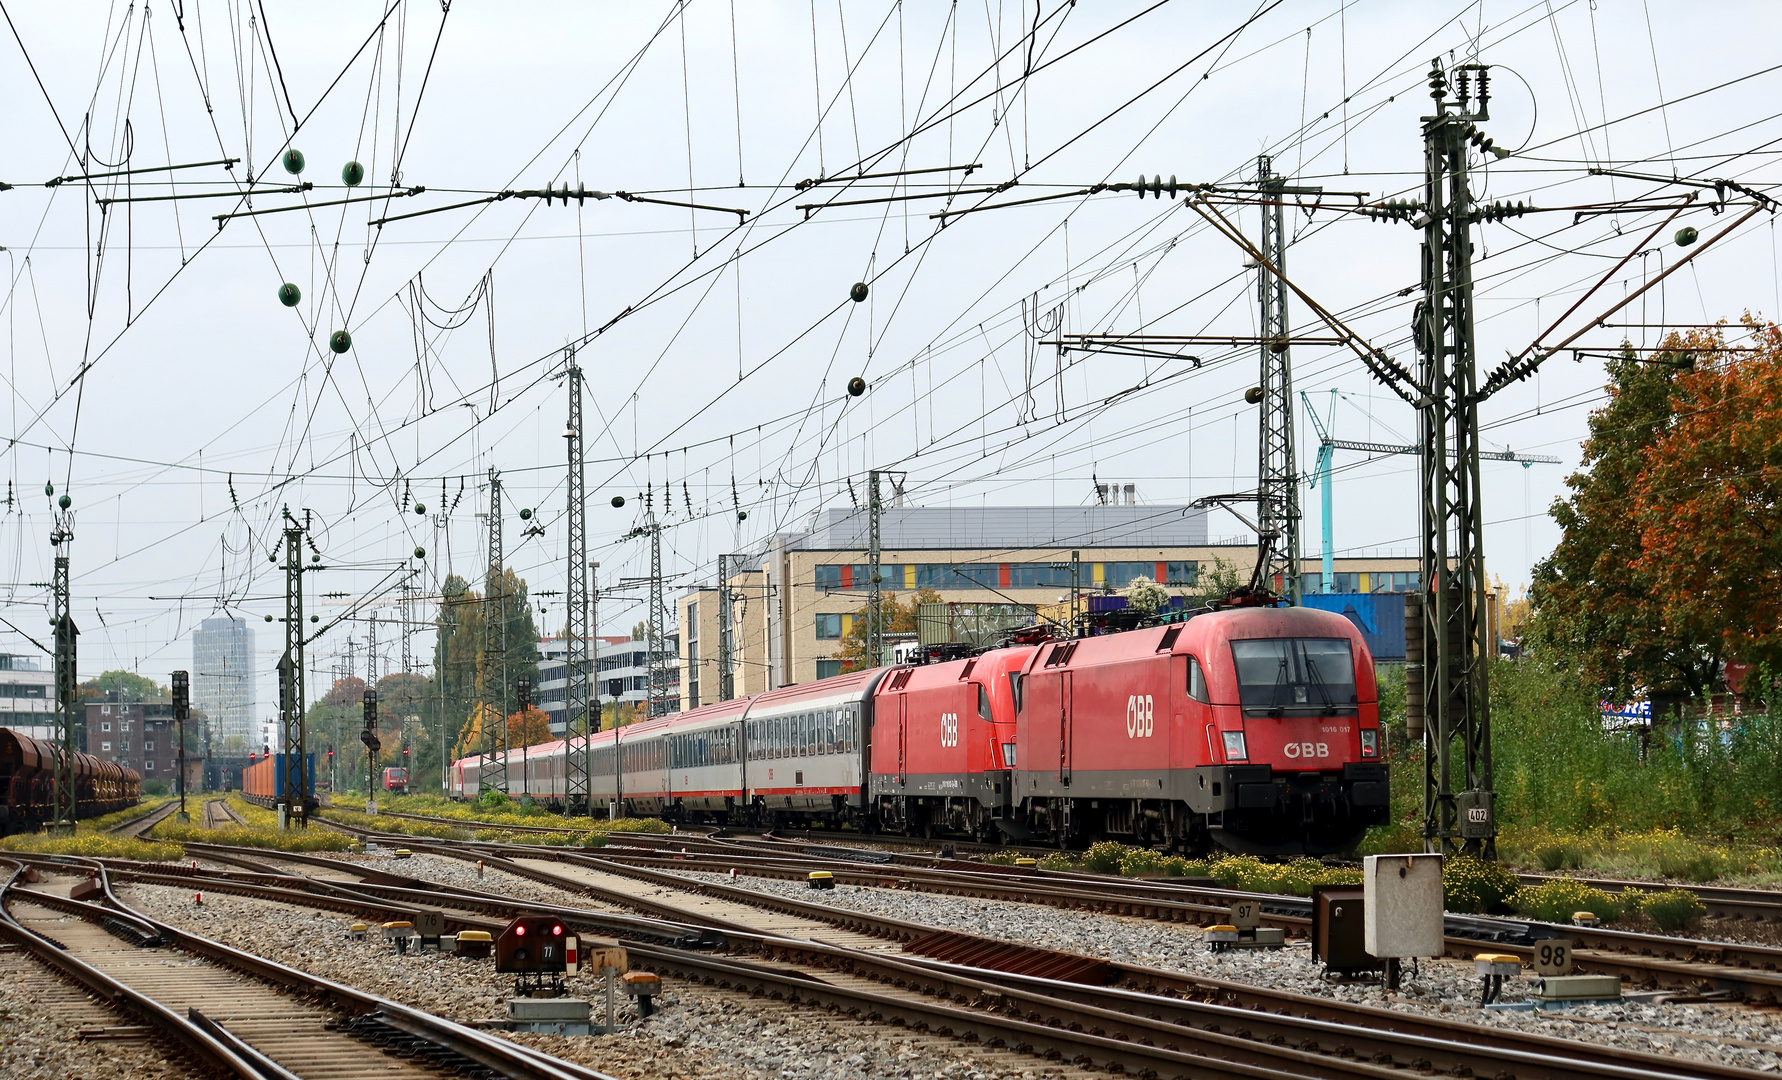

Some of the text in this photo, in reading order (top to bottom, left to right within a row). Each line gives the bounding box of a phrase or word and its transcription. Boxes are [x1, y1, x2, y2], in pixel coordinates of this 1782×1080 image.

[1127, 695, 1153, 738] ÖBB
[941, 713, 957, 748] ÖBB
[1284, 742, 1329, 758] ÖBB
[1470, 810, 1486, 821] 402
[1238, 905, 1252, 919] 97
[424, 914, 437, 927] 76
[543, 946, 553, 958] 77
[1540, 945, 1565, 967] 98
